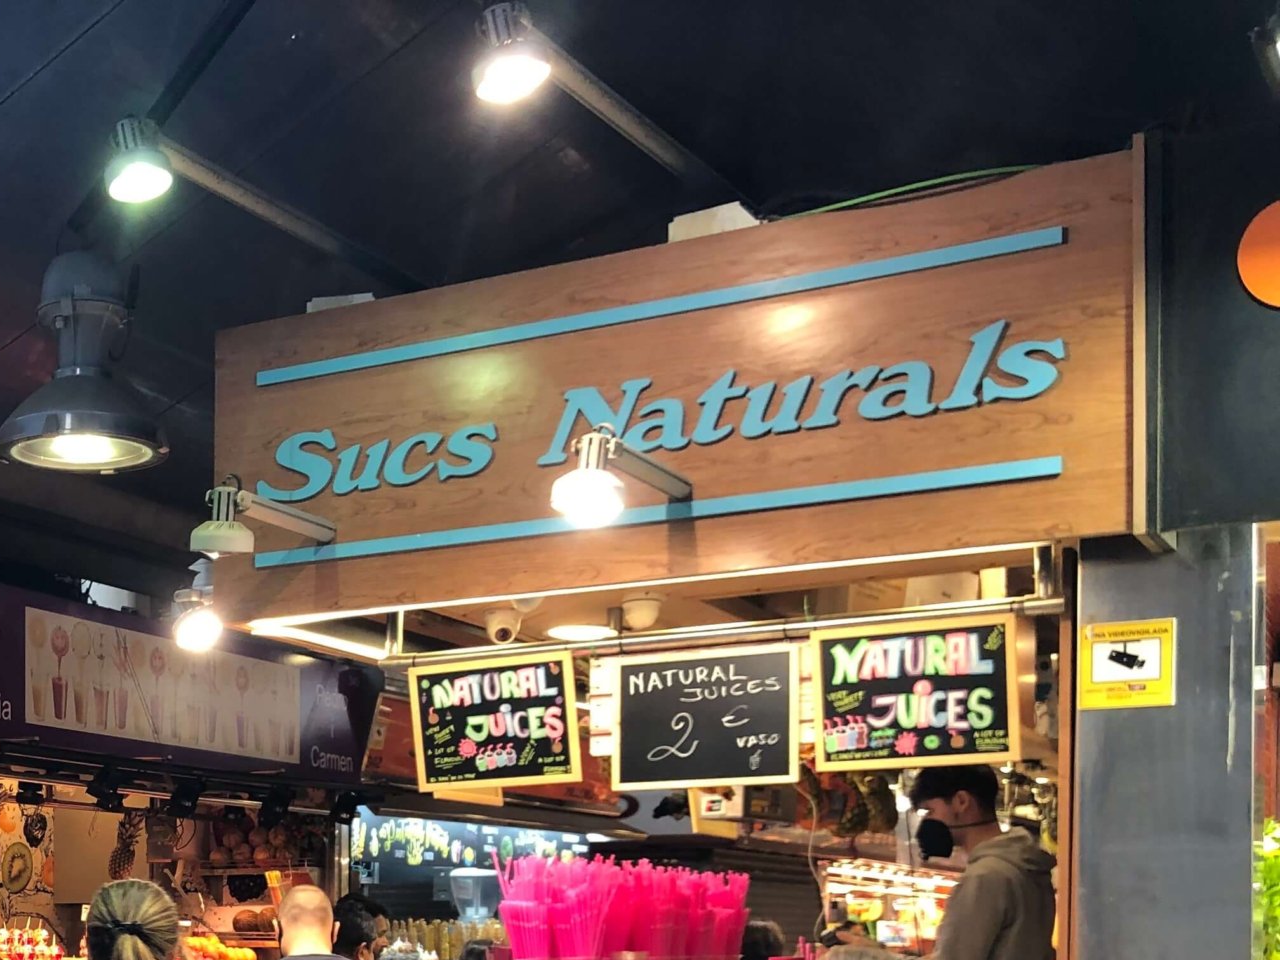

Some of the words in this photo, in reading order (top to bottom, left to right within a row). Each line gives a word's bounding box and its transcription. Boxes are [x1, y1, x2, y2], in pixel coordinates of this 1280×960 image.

[256, 421, 498, 503] Sucs
[538, 320, 1070, 467] Naturals
[628, 663, 748, 696] NATURAL
[829, 631, 995, 686] NATURAL
[431, 665, 559, 710] NATURAL
[679, 676, 783, 702] JUICES
[866, 679, 994, 730] JUICES
[464, 703, 565, 742] JUICES
[646, 711, 700, 762] 2
[735, 733, 781, 749] VASO
[310, 745, 354, 773] Carmen
